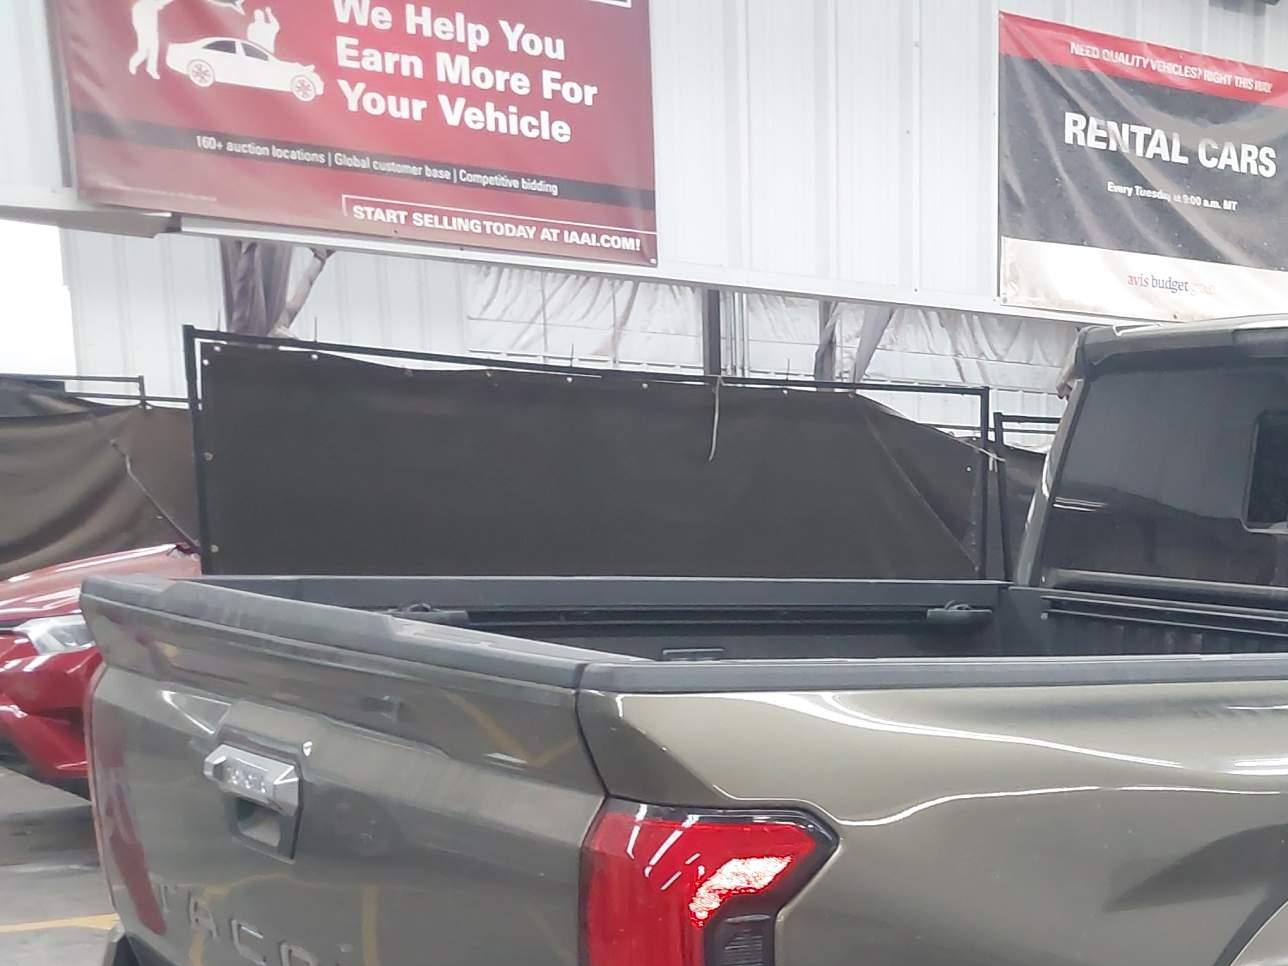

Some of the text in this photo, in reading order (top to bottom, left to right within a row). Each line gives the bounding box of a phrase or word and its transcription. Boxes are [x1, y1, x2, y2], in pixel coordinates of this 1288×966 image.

[333, 0, 565, 60] We Help You
[335, 36, 598, 106] Earn More For
[1070, 41, 1099, 59] NEED
[1101, 49, 1150, 69] QUALITY
[1149, 59, 1202, 80] VEHICLES?
[1204, 70, 1233, 86] RIGHT
[1234, 76, 1254, 91] THIS
[337, 79, 571, 143] Your Vehicle
[196, 135, 223, 151] 160+
[226, 142, 269, 158] auction
[271, 145, 326, 164] locations
[334, 153, 370, 170] Global
[373, 160, 422, 177] customer
[424, 165, 450, 180] base
[459, 169, 519, 189] Competitive
[521, 178, 559, 196] bidding
[1064, 112, 1277, 178] RENTAL CARS
[1107, 181, 1133, 197] Every
[1134, 185, 1171, 202] Tuesday
[352, 205, 641, 252] START SELLING TODAY AT IAAI.COM!
[1127, 274, 1149, 288] avis
[1151, 274, 1189, 294] budget
